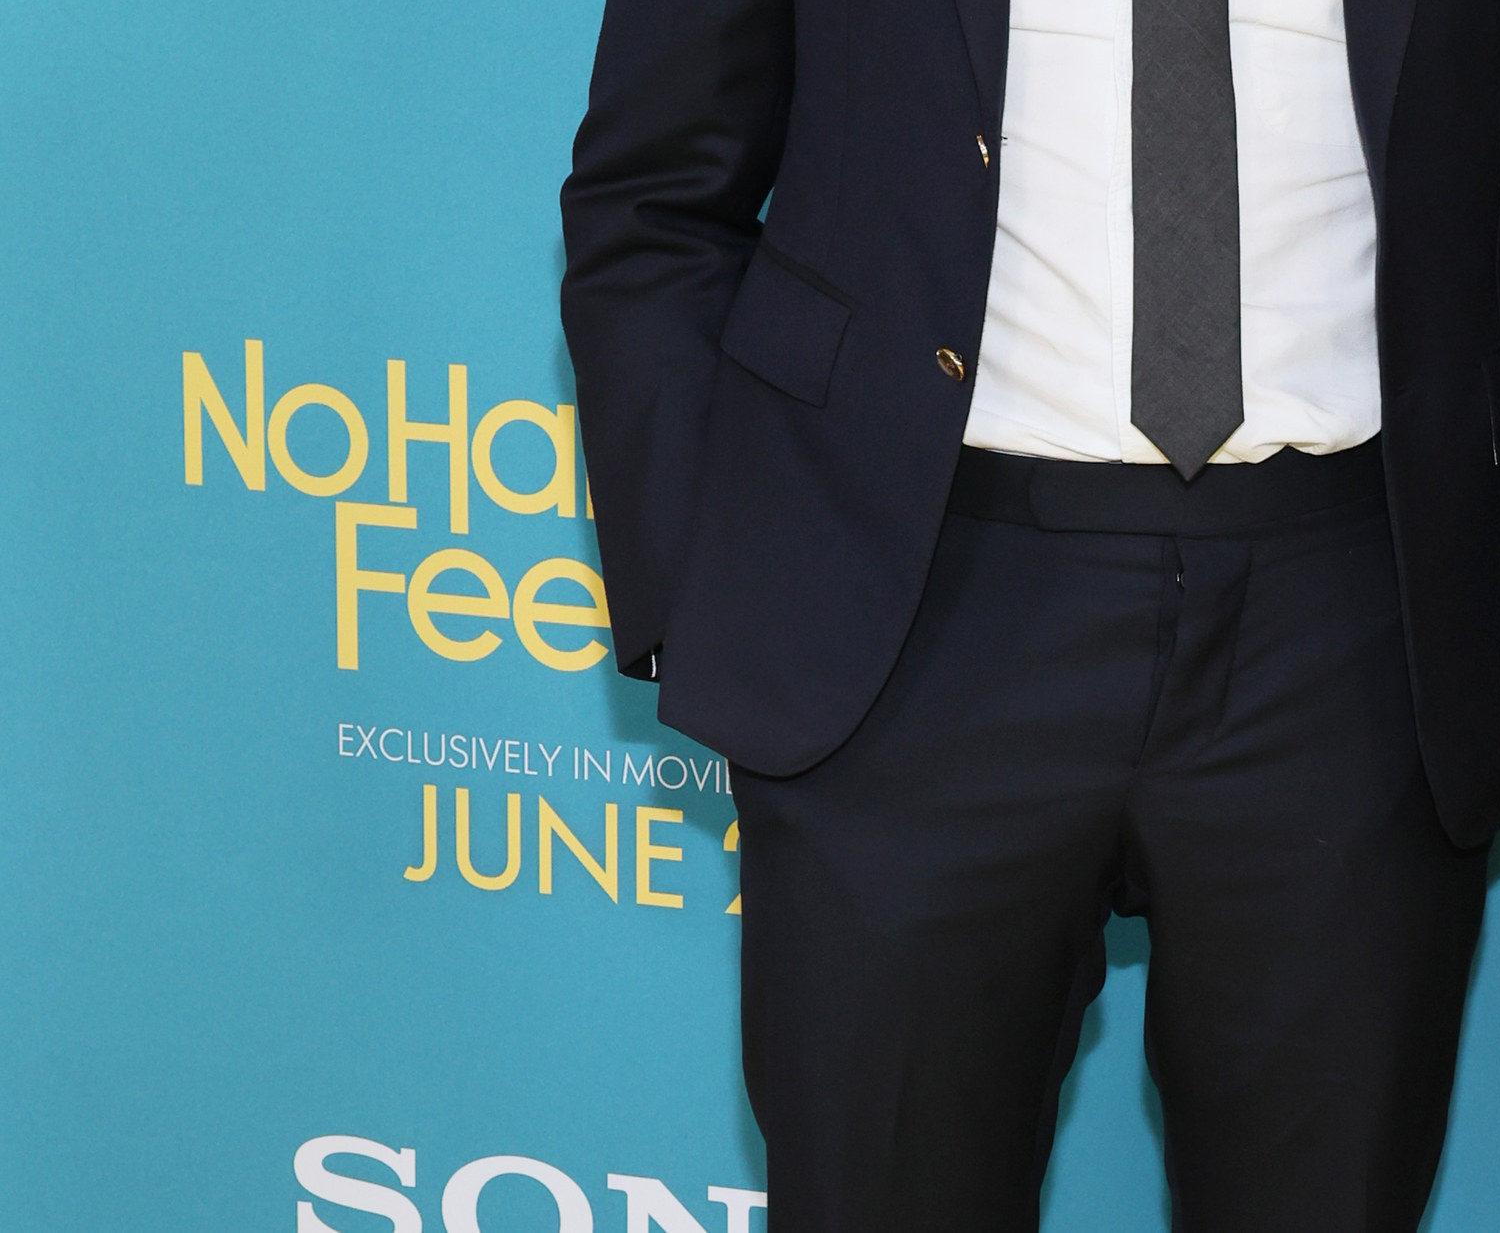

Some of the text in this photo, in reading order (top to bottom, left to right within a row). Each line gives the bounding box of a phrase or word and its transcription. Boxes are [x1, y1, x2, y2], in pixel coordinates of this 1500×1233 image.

[182, 338, 595, 535] No Ha
[335, 500, 612, 672] Fee
[338, 723, 563, 777] EXCLUSIVELY
[574, 746, 612, 783] IN
[403, 783, 684, 910] JUNE
